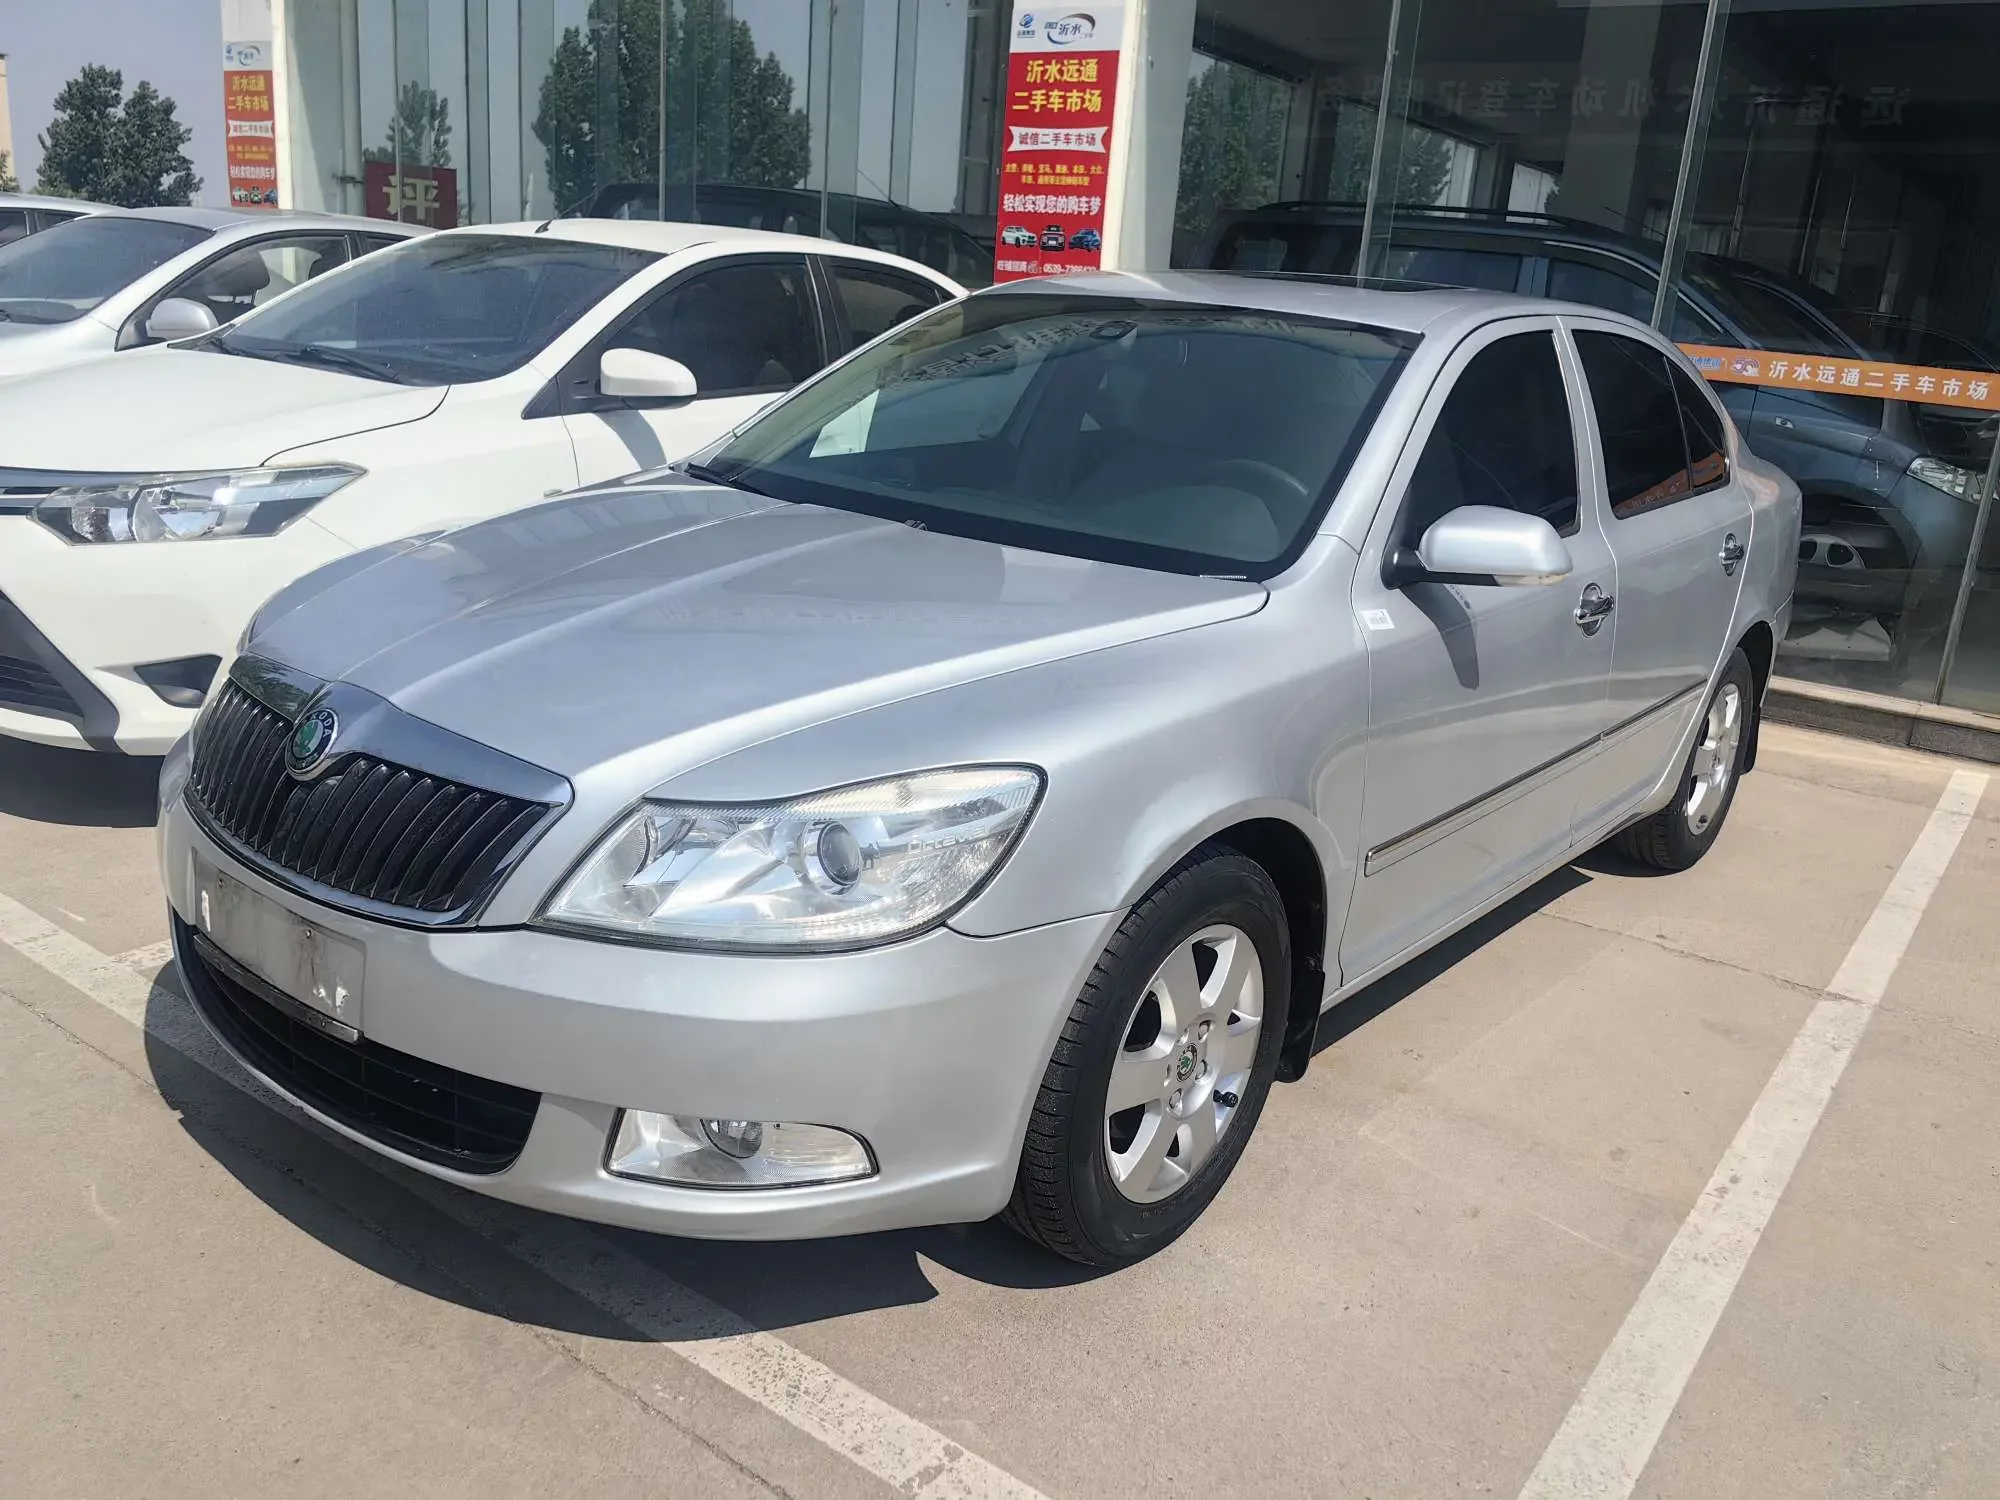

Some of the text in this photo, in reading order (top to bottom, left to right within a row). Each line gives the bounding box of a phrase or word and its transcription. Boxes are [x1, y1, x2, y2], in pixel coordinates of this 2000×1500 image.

[1026, 58, 1099, 83] 沂水远通
[1012, 89, 1102, 113] 二手车市场
[1768, 359, 1991, 401] 沂水远通二手车市场
